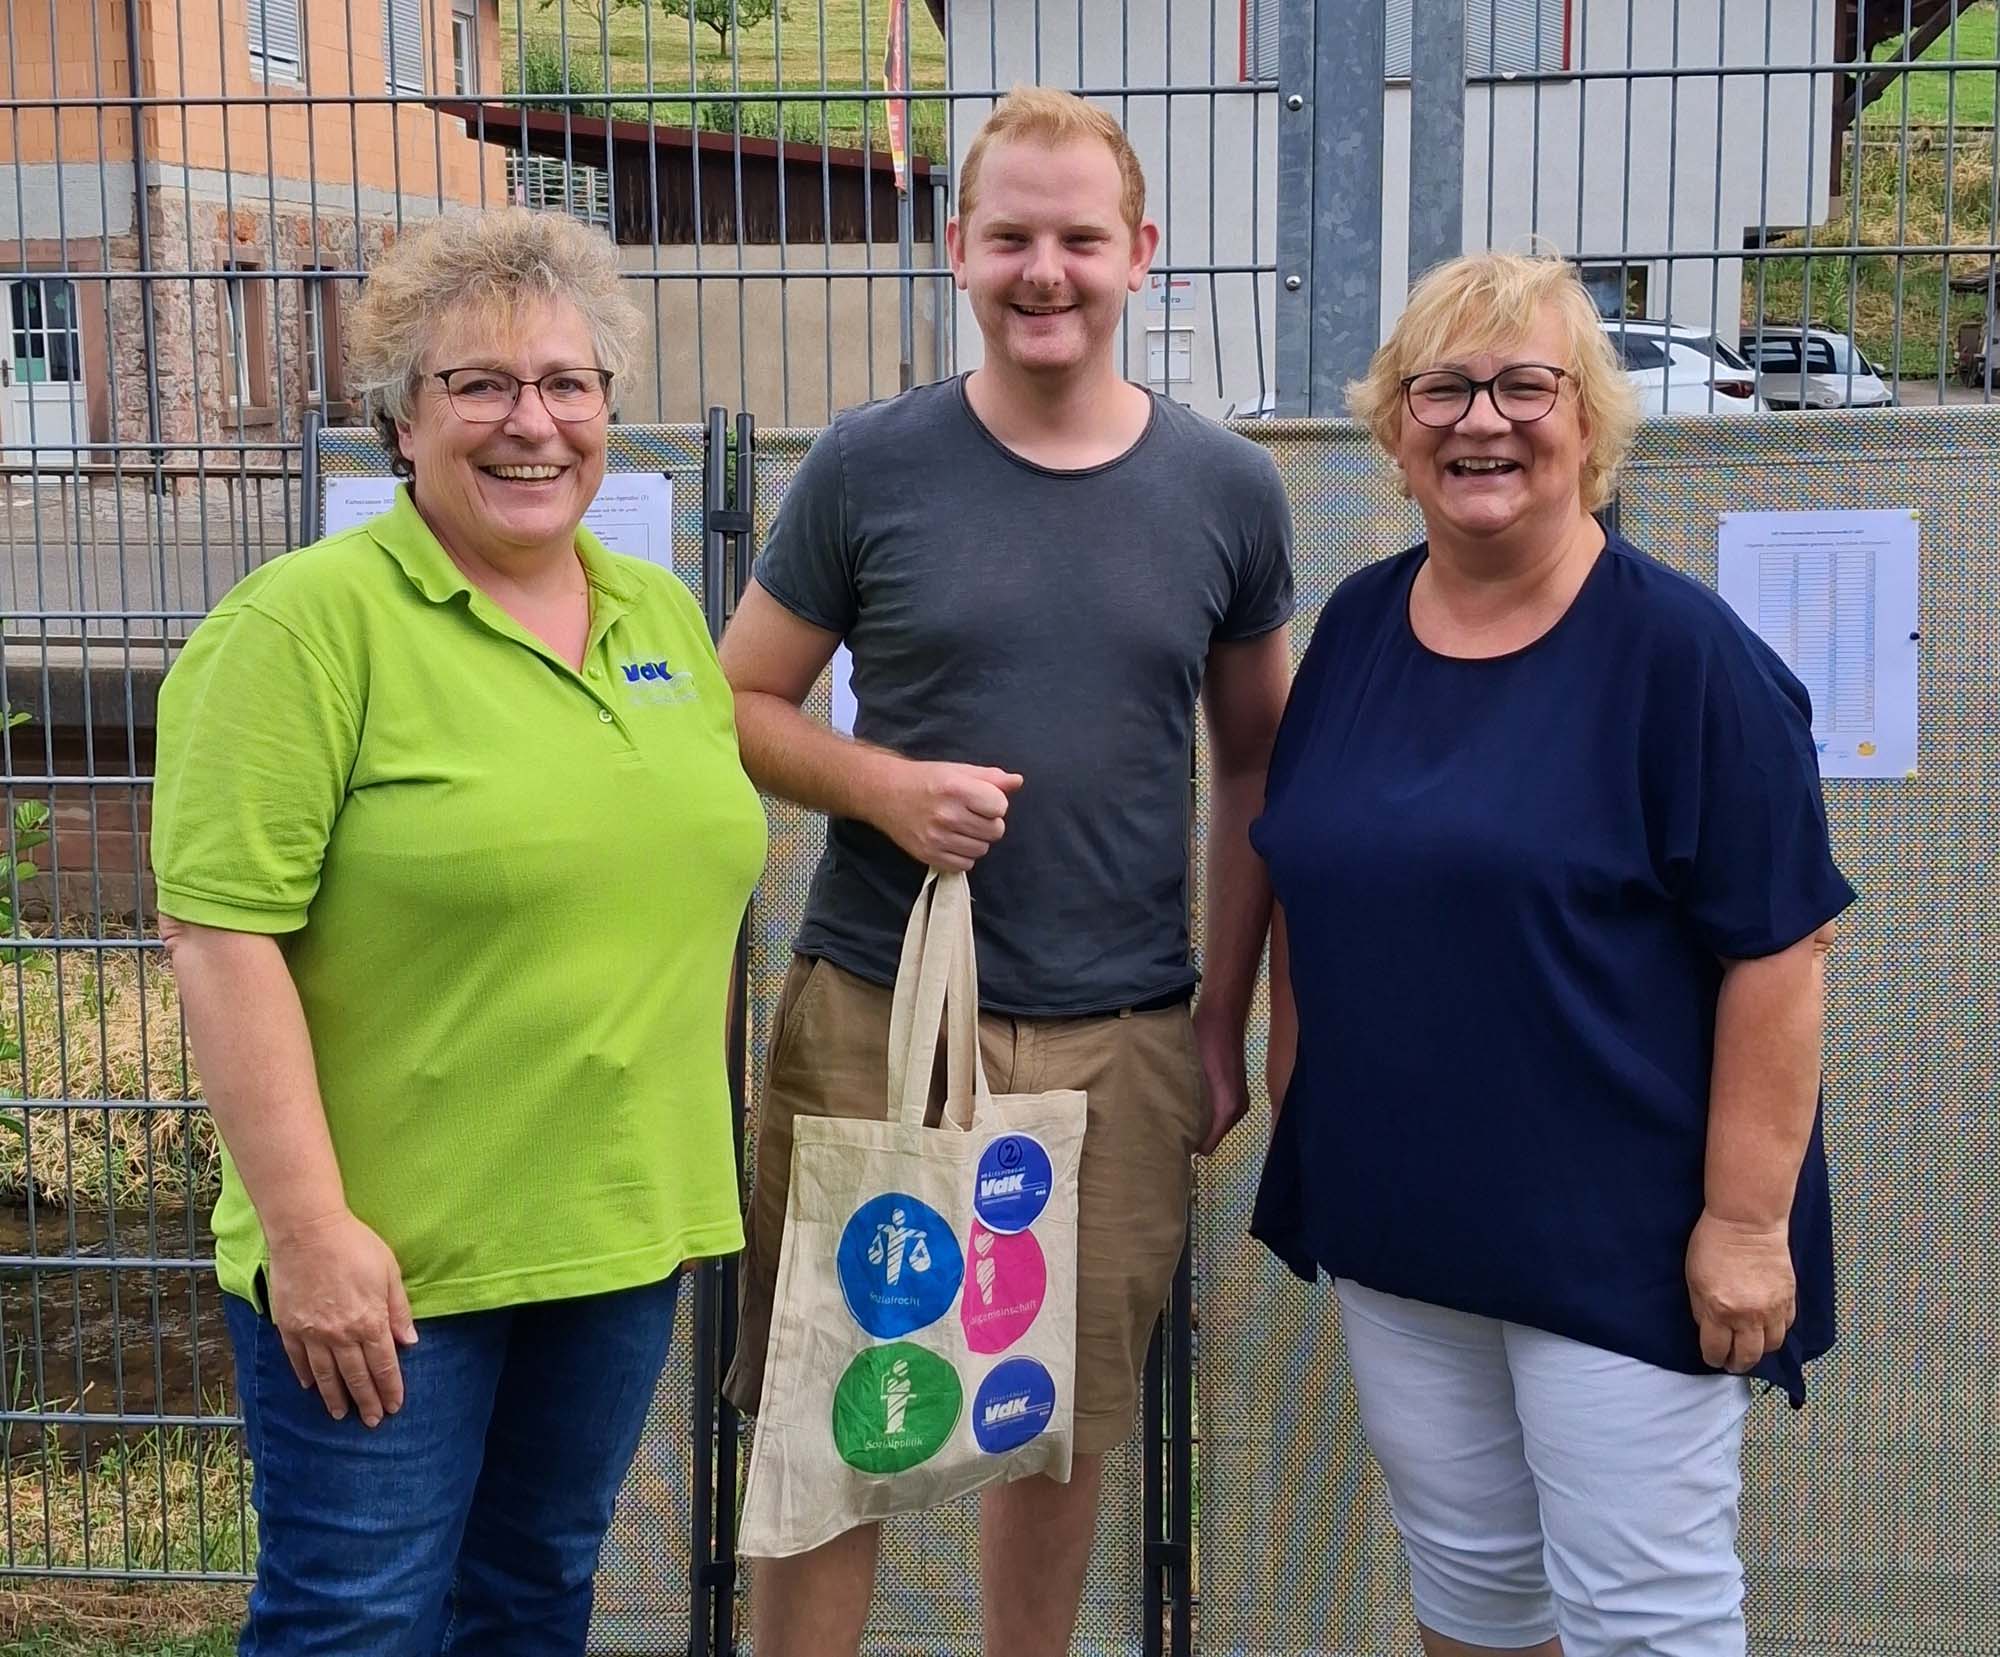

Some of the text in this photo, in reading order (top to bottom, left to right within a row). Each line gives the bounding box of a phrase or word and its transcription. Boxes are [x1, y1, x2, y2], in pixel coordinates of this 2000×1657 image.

[621, 660, 673, 682] VdK
[981, 1173, 1025, 1197] VdK
[985, 1396, 1030, 1422] VdK
